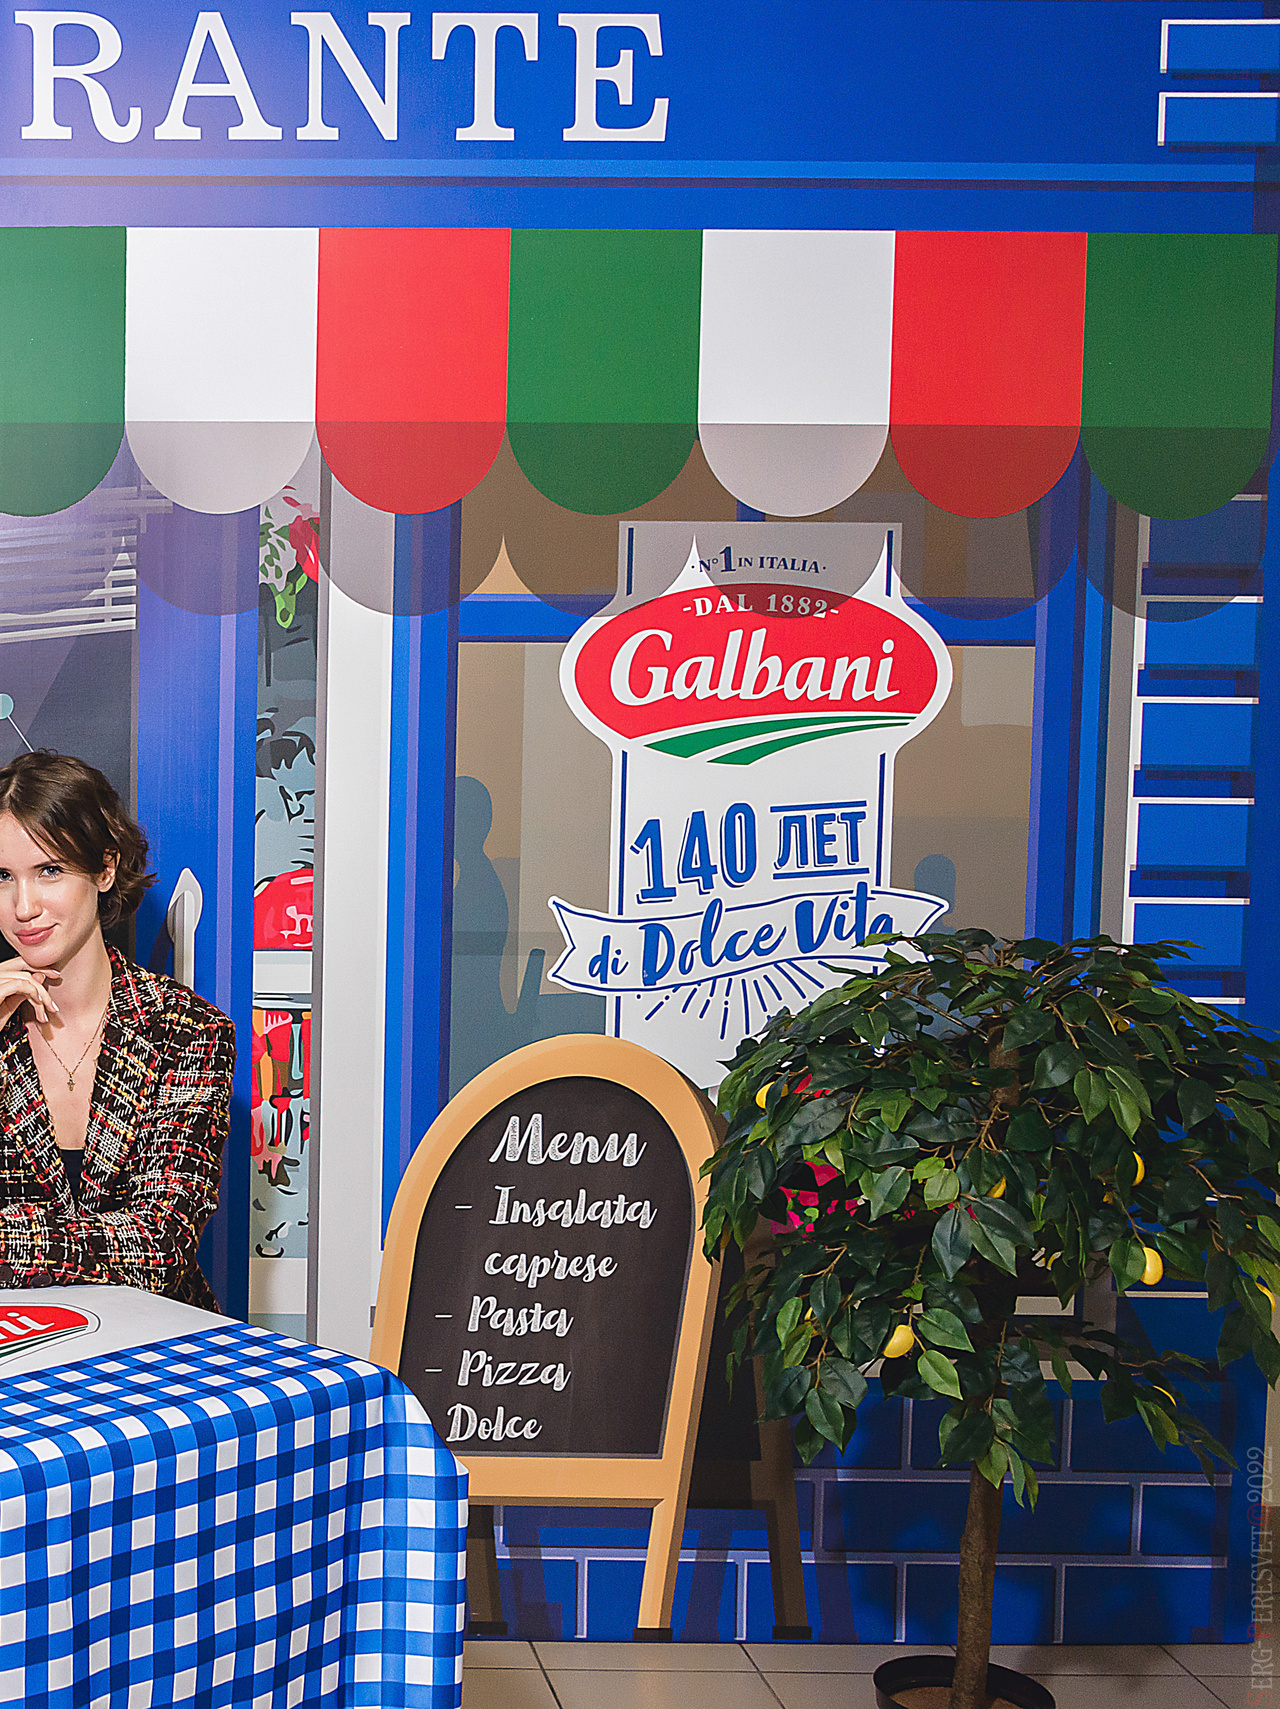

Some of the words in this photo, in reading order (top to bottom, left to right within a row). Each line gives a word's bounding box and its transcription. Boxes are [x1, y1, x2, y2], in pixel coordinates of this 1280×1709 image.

[738, 556, 753, 568] IN
[758, 556, 820, 573] ITALIA
[610, 628, 901, 706] Galbani
[630, 803, 757, 904] 140
[773, 811, 867, 870] ЛЕТ
[588, 935, 629, 985] di
[639, 898, 787, 986] Dolce
[795, 881, 897, 954] Vita
[489, 1113, 647, 1167] Menu
[489, 1185, 658, 1229] Insalata
[484, 1250, 618, 1289] caprese
[467, 1295, 575, 1337] Pasta
[457, 1350, 572, 1392] Pizza
[445, 1403, 543, 1442] Dolce
